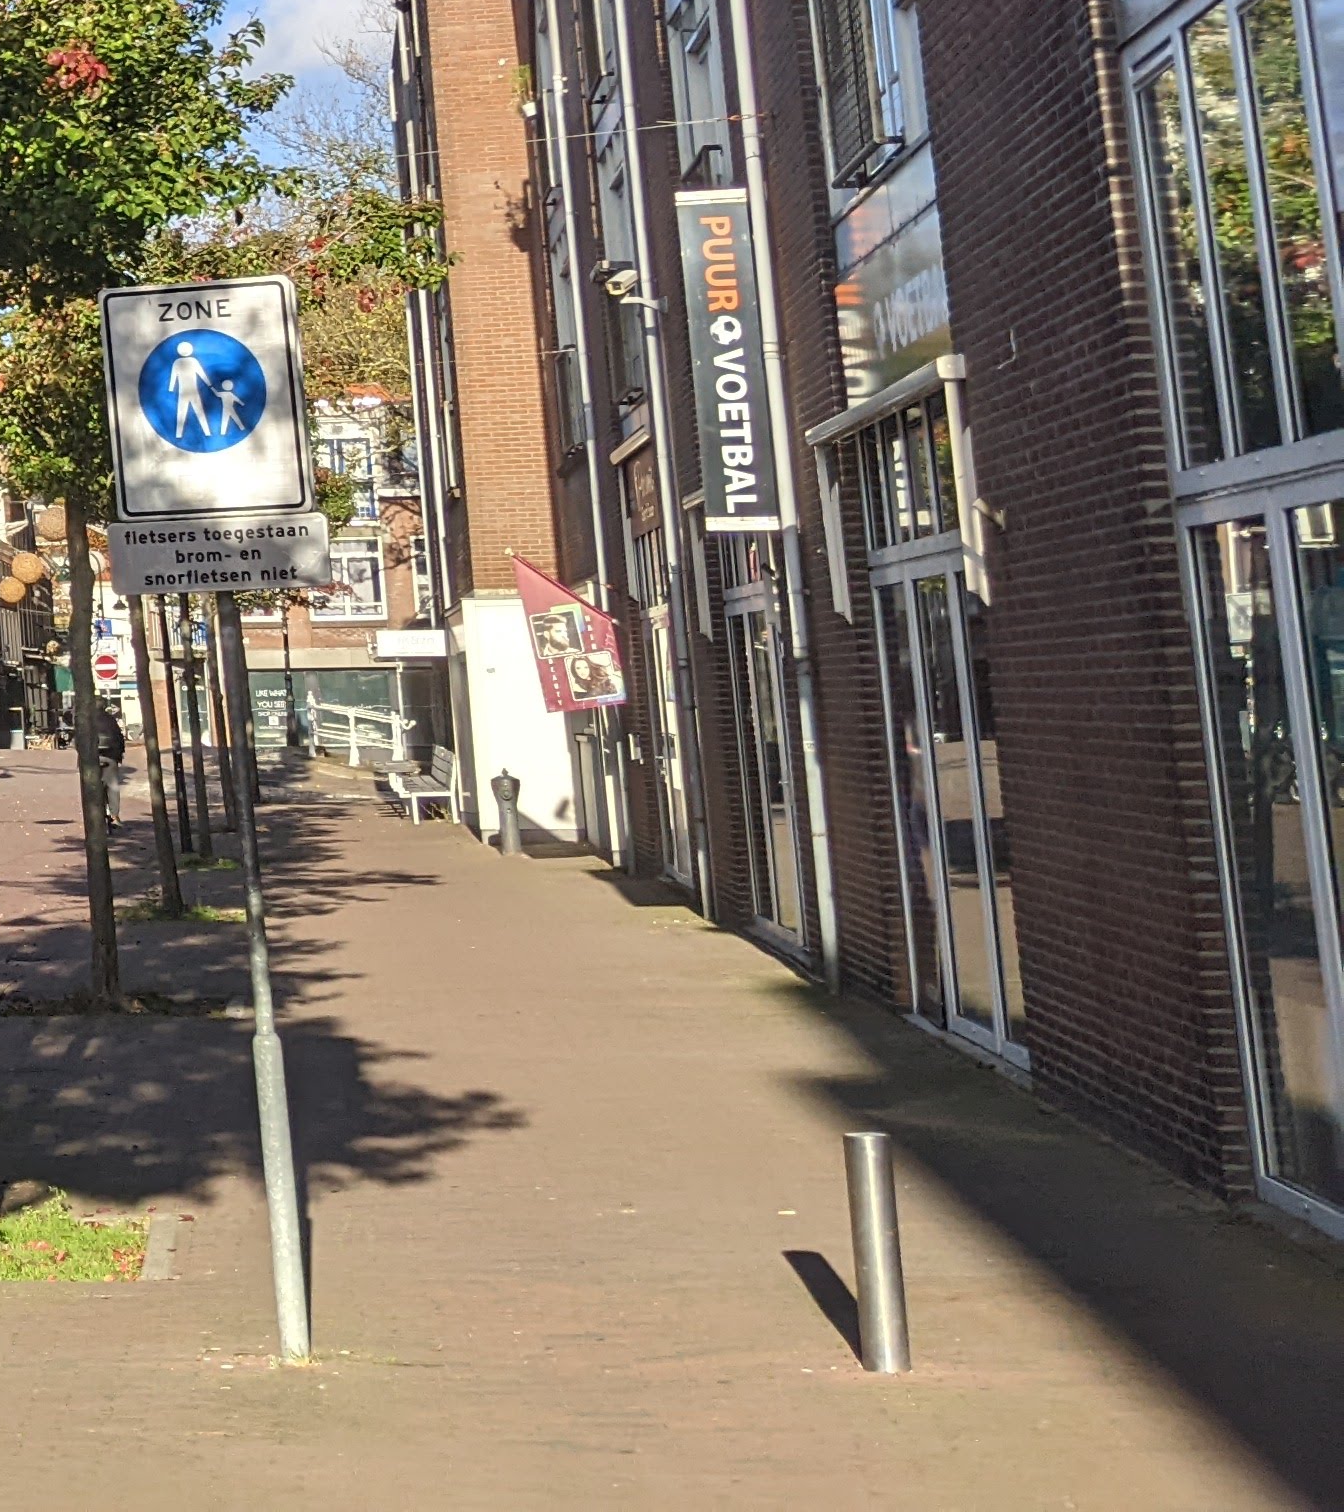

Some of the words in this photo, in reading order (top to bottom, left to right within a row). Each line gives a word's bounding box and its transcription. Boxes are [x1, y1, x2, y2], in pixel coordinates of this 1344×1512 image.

[699, 215, 741, 313] PUUR
[158, 298, 232, 322] ZONE
[712, 348, 758, 514] VOETBAL
[124, 526, 197, 545] fietsers
[203, 524, 310, 544] toegestaan
[175, 549, 232, 564] brom-
[239, 549, 262, 562] en
[144, 568, 252, 586] snorfietsen
[260, 566, 299, 582] niet
[256, 700, 273, 708] YOU
